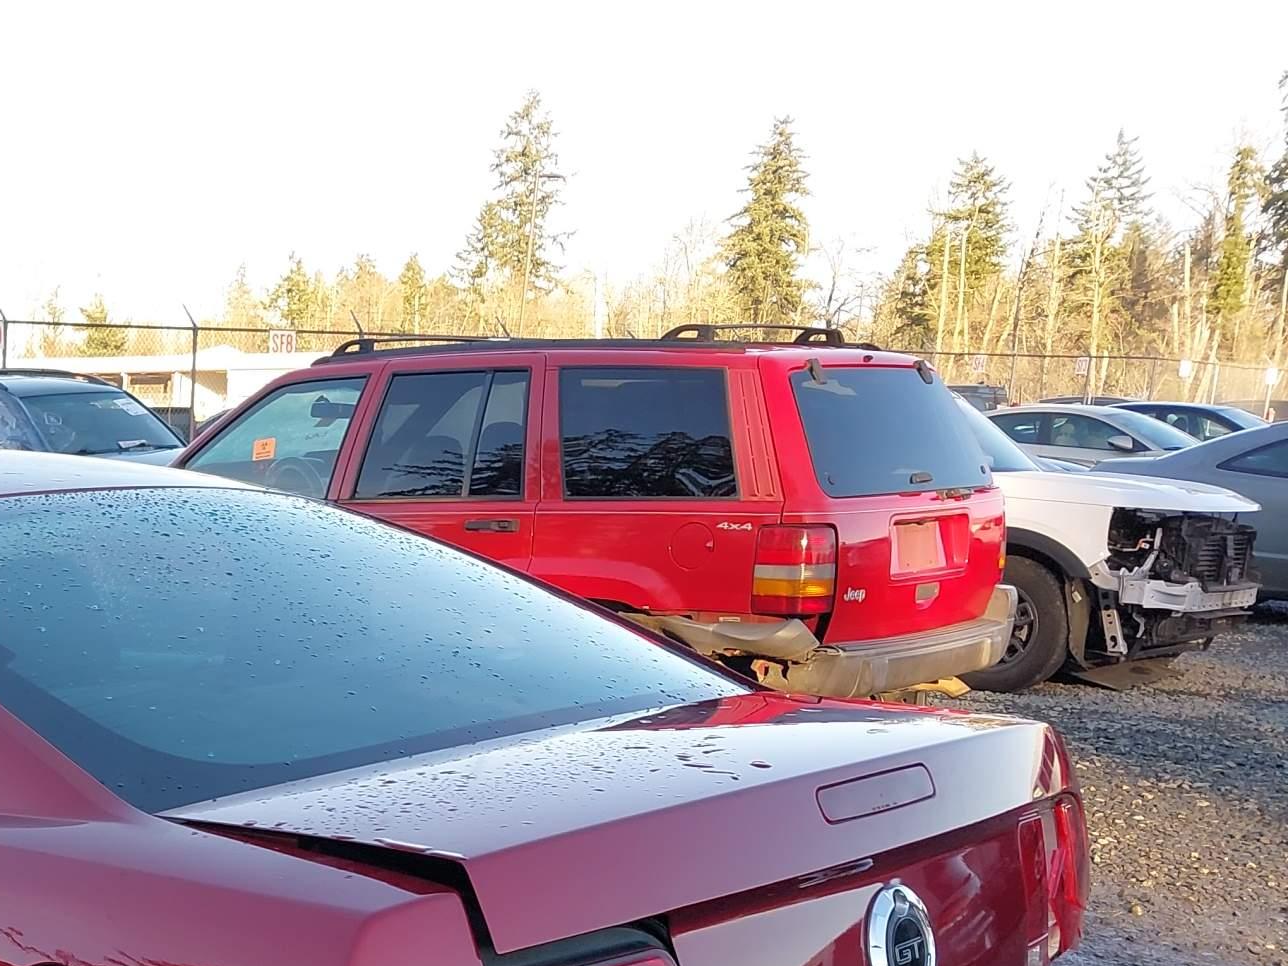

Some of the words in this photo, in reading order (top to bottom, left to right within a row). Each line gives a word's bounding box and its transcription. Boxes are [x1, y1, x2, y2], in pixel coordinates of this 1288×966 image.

[272, 333, 293, 353] SF8
[843, 586, 866, 603] Jeep
[895, 936, 923, 966] GT
